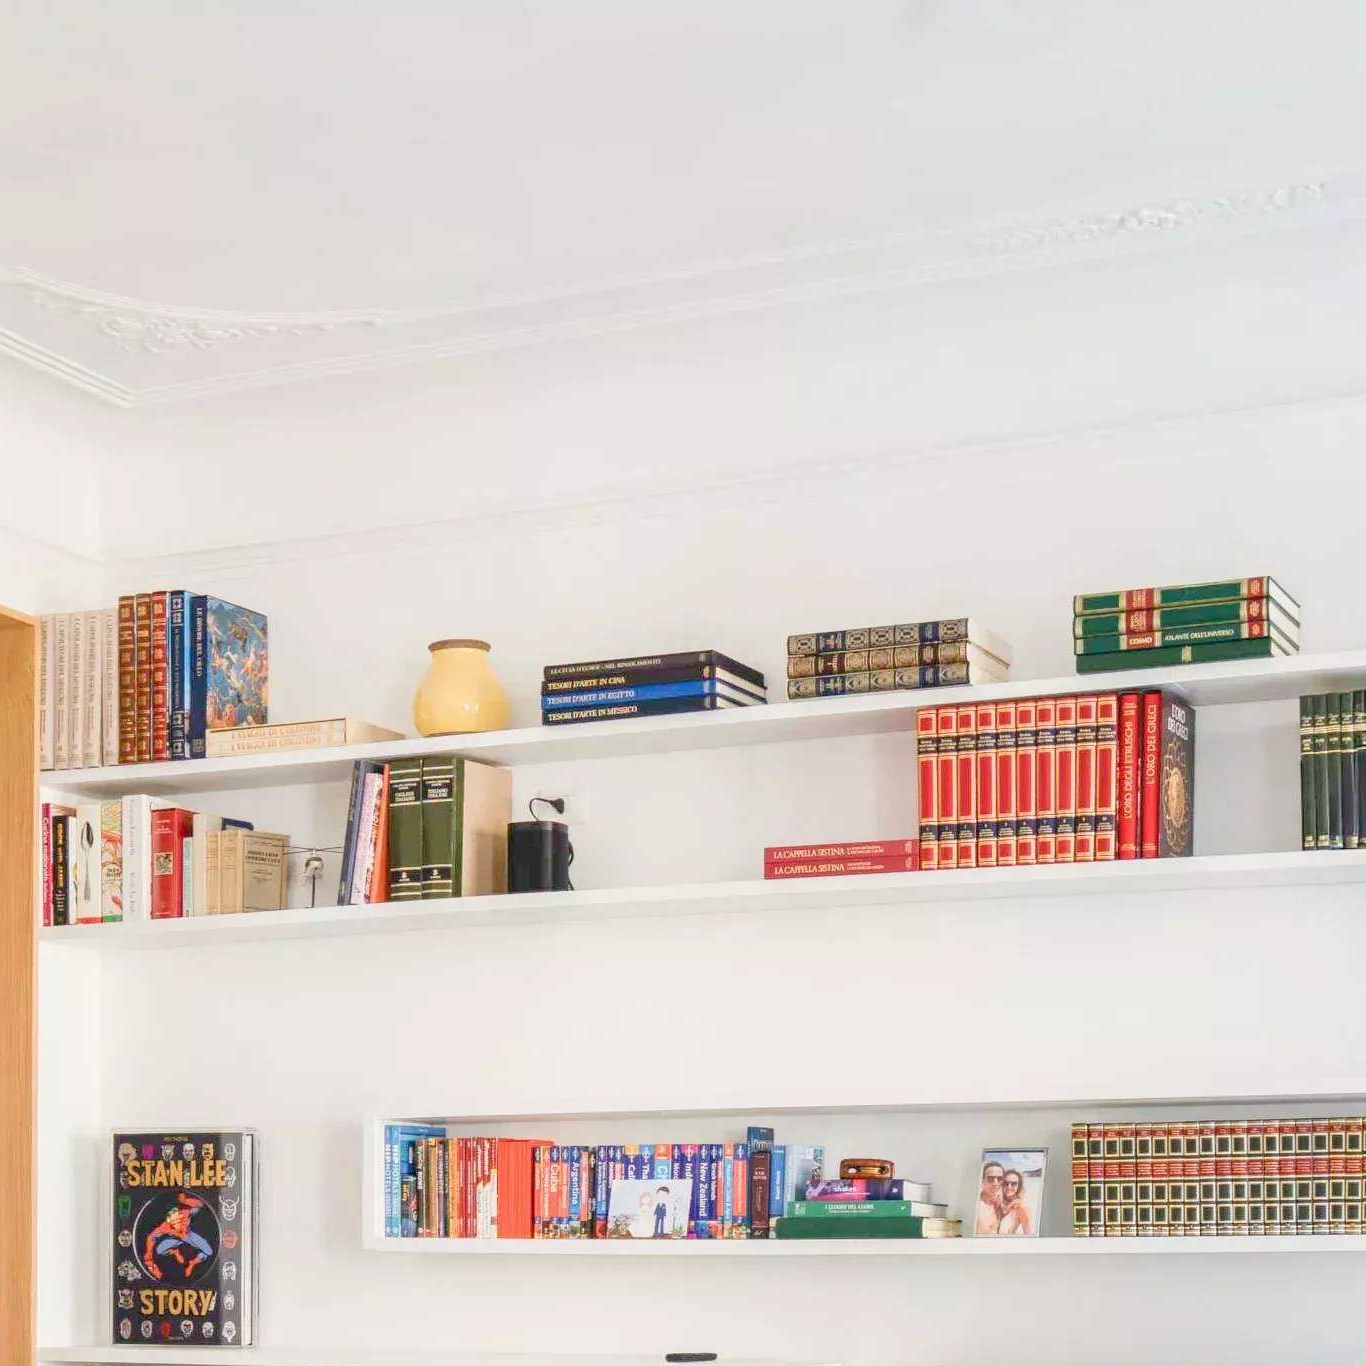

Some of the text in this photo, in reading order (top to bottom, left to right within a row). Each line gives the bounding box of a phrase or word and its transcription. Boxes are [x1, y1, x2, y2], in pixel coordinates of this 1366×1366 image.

[547, 681, 571, 691] TESORI
[572, 678, 597, 688] D'ARTE
[607, 676, 626, 685] CINA
[547, 695, 571, 705] TESORI
[572, 693, 597, 703] D'ARTE
[607, 689, 635, 700] EGITTO
[548, 712, 571, 722] TESORI
[572, 710, 597, 720] D'ARTE
[607, 705, 638, 716] MESSICO
[1146, 704, 1158, 785] L'ORO DEI GRECI
[773, 851, 782, 860] LA
[783, 849, 816, 859] CAPPELLA
[817, 848, 845, 857] SISTINA
[774, 866, 784, 875] LA
[784, 865, 817, 874] CAPPELLA
[817, 864, 845, 873] SISTINA
[126, 1158, 227, 1187] STAN LEE
[550, 1163, 559, 1193] Cuba
[699, 1162, 708, 1217] New Zealand
[139, 1289, 214, 1316] STORY
